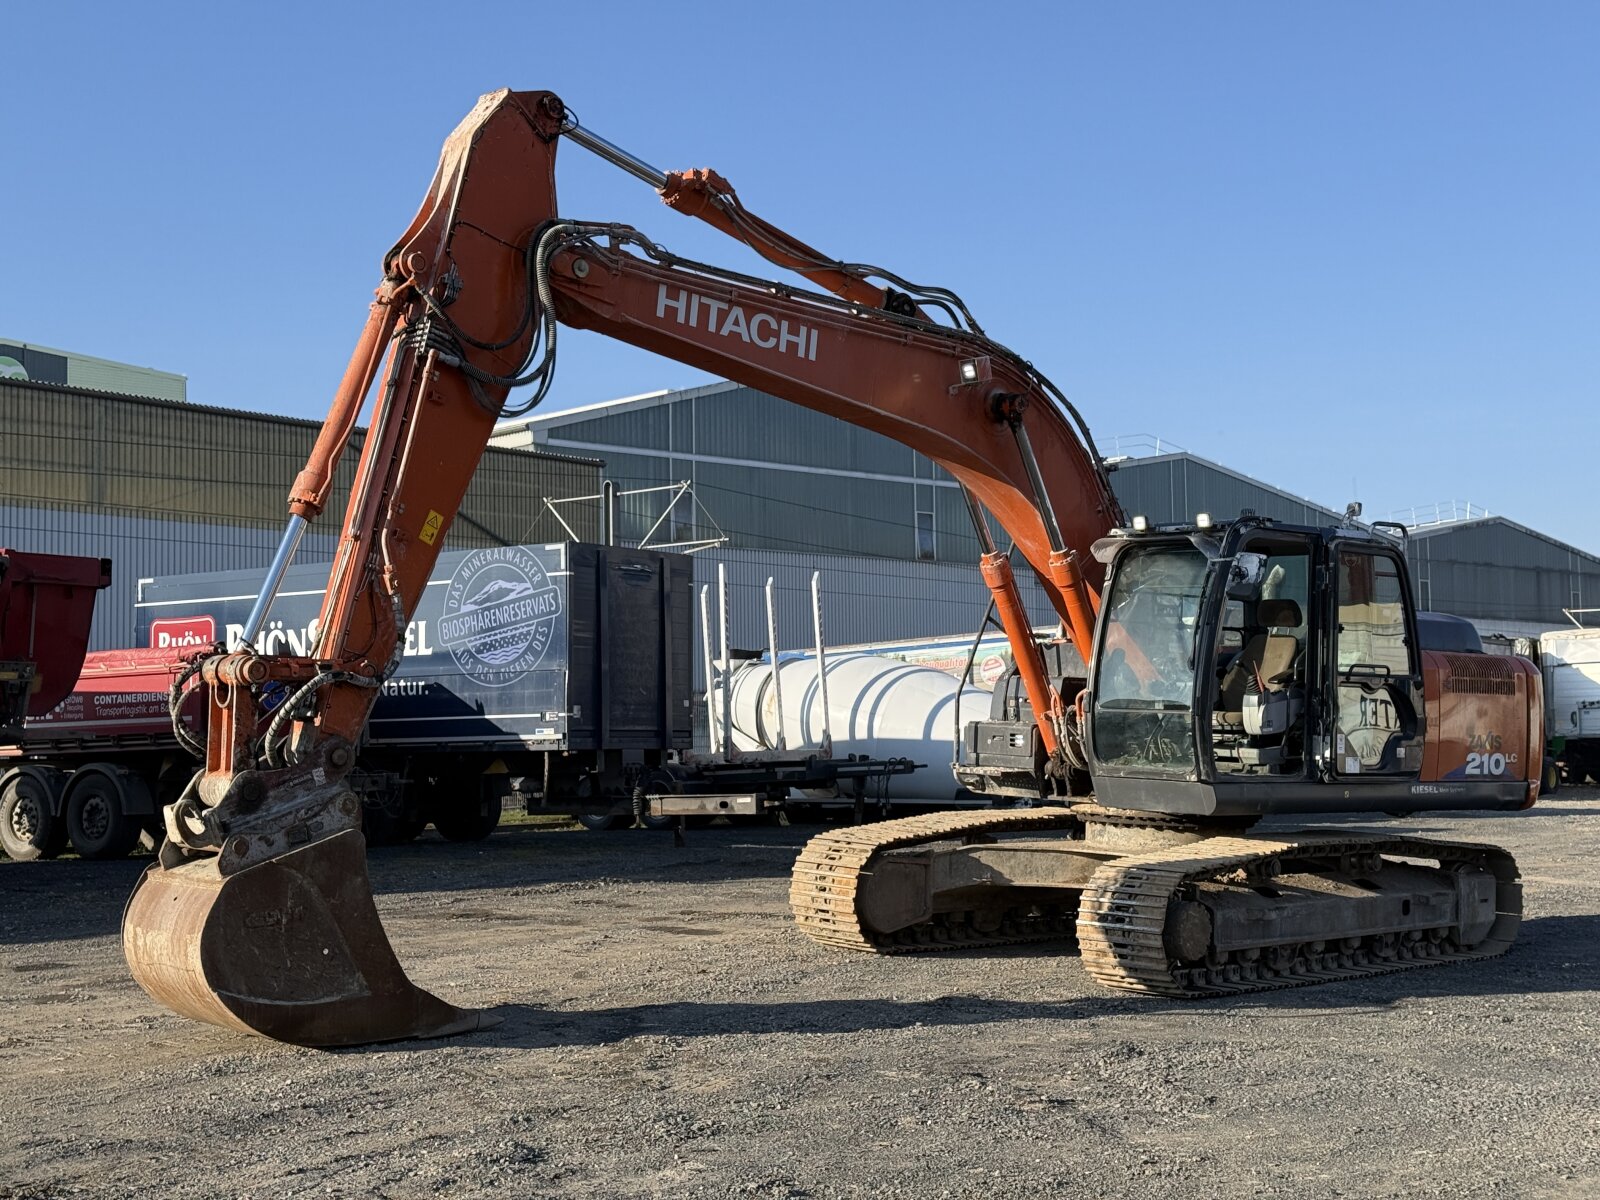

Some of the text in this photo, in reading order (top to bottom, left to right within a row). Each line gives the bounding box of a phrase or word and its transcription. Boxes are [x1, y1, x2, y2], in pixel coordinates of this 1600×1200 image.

[656, 283, 818, 361] HITACHI
[449, 548, 542, 608] DAS MINERALWASSER
[442, 592, 556, 640] BIOSPHÄRENRESERVATS
[455, 625, 548, 681] AUS DEN TIEFEN DES
[94, 692, 169, 705] CONTAINERDIENS
[1411, 785, 1439, 794] KIESEL
